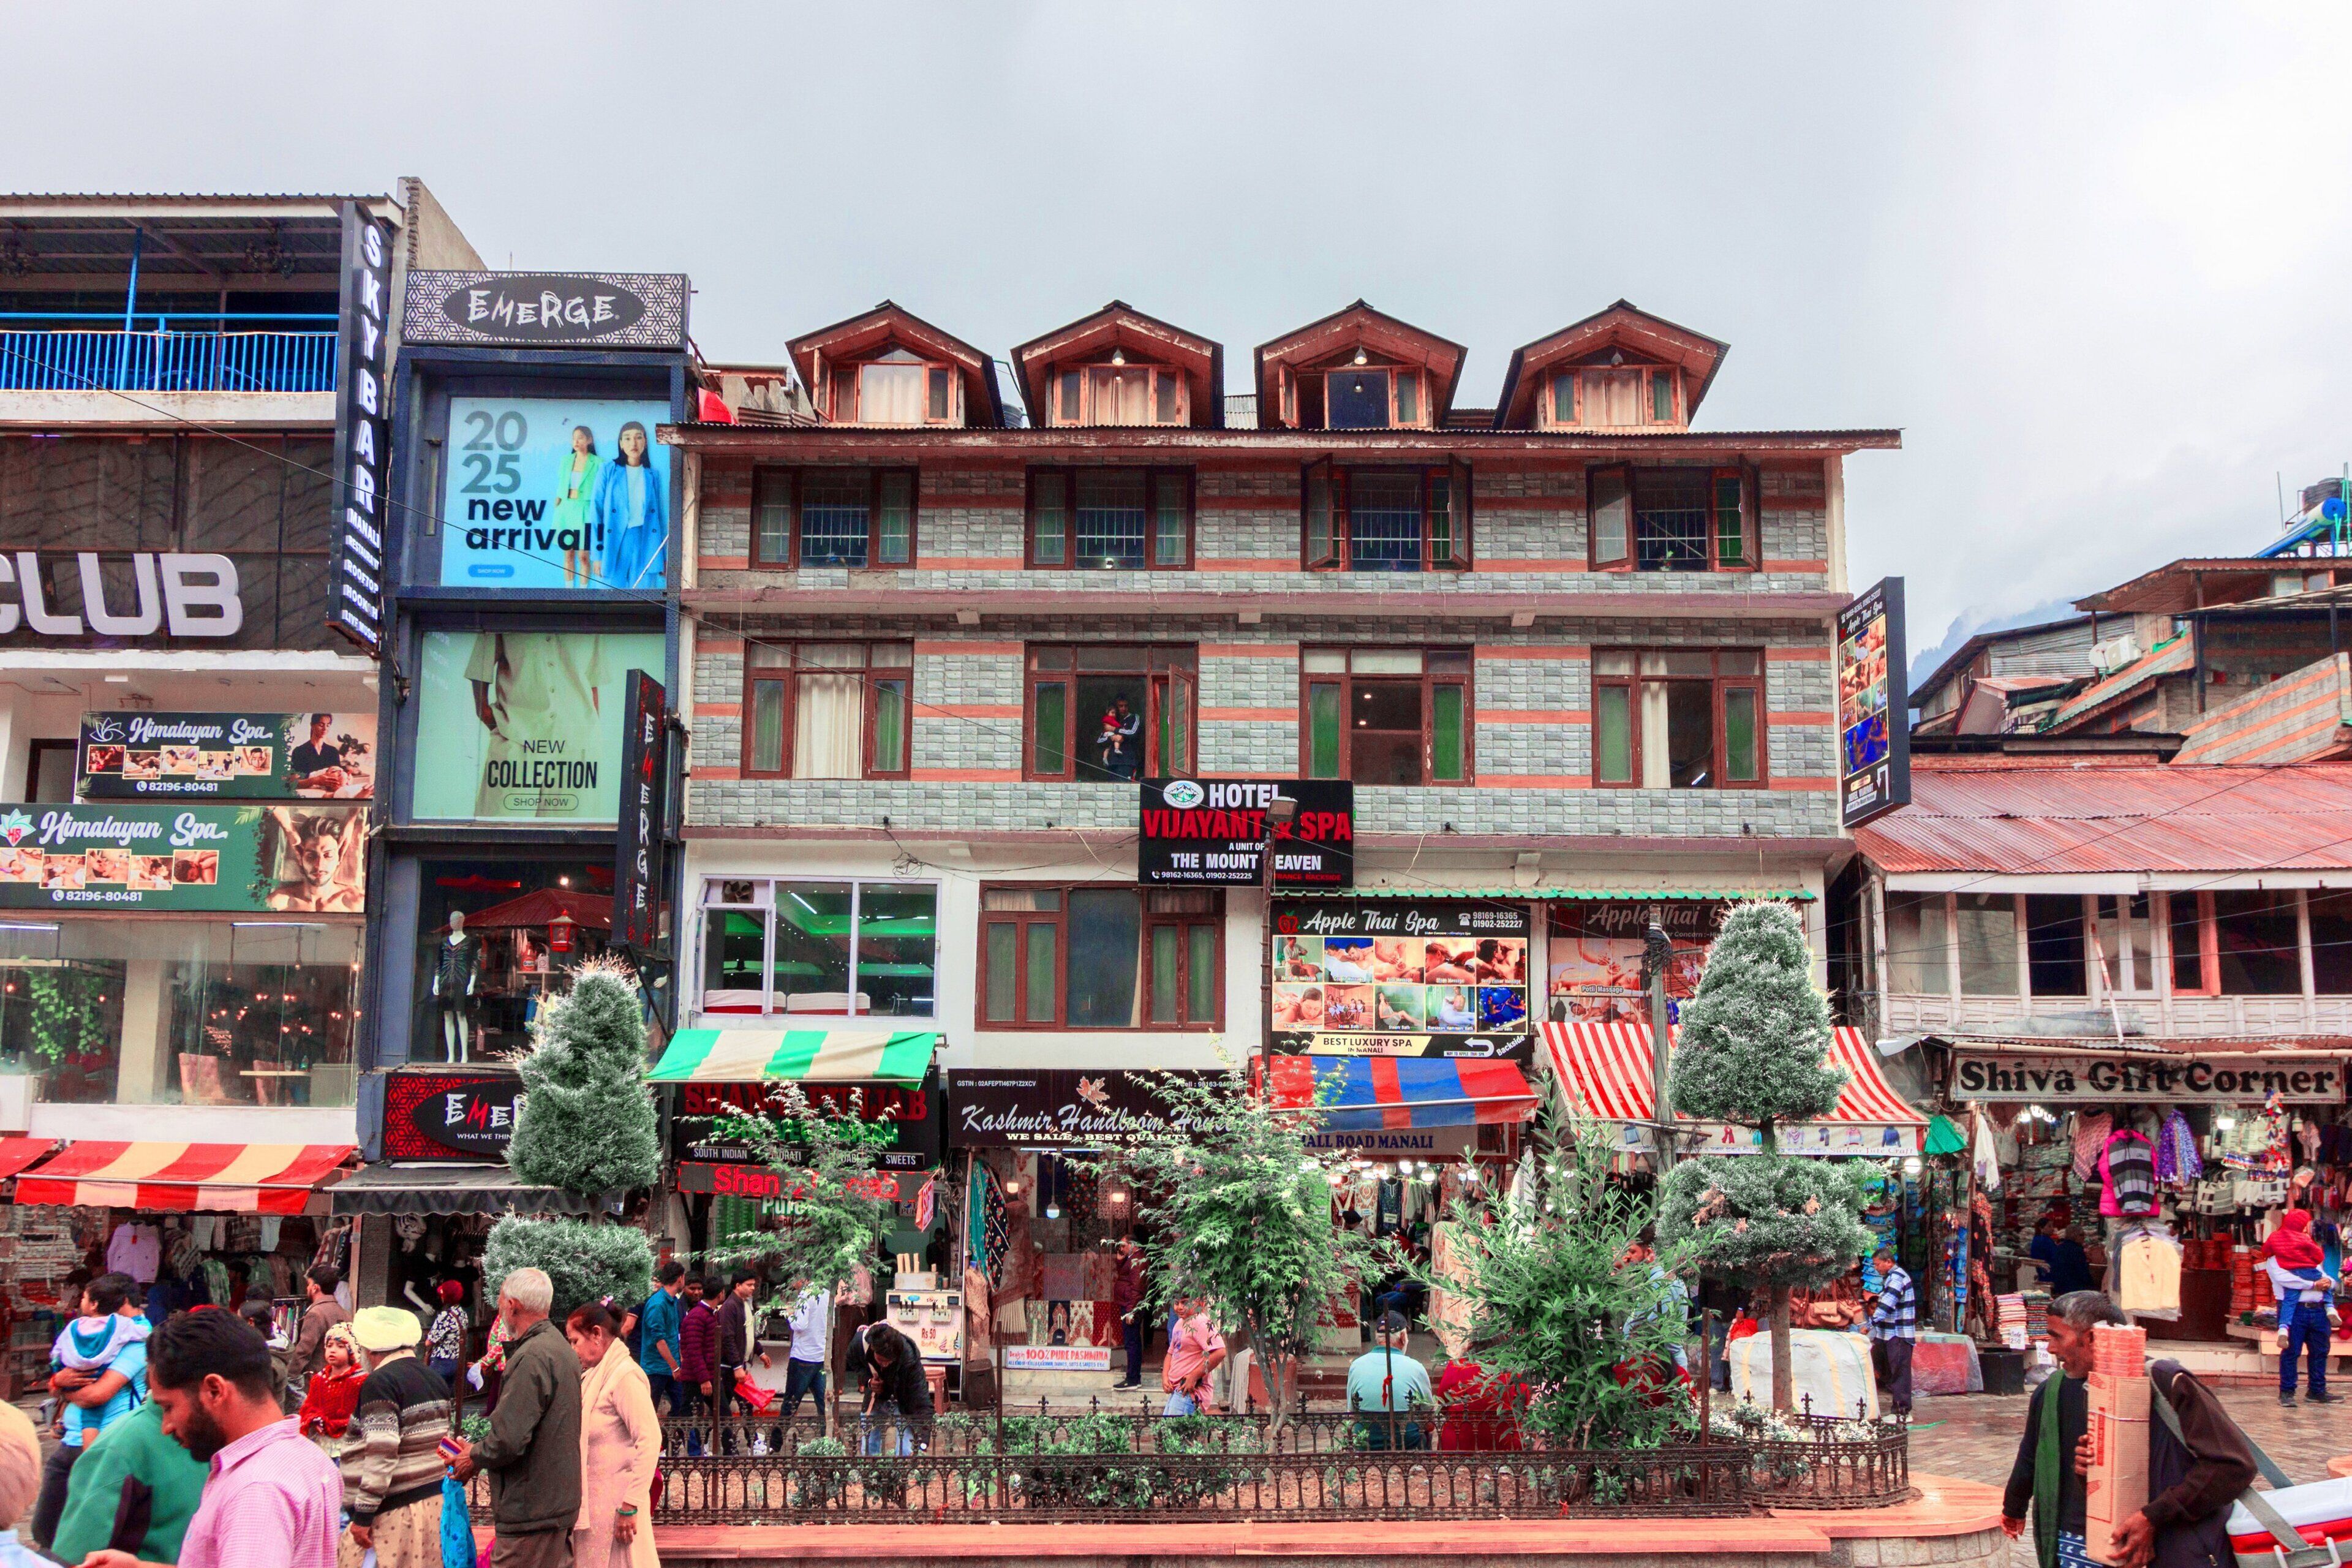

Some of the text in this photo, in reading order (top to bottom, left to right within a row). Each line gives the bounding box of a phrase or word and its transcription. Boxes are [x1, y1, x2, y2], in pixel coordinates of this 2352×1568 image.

[468, 290, 615, 330] EMERGE
[462, 410, 528, 451] 20
[460, 453, 522, 494] 25
[468, 496, 547, 521] new
[346, 508, 380, 549] MANALI
[466, 519, 605, 551] arrival!
[344, 559, 379, 594] ROOFTOP
[128, 717, 273, 744] Himalayan Spa
[524, 740, 565, 753] NEW
[149, 782, 218, 792] 82196-80481
[488, 760, 597, 788] COLLECTION
[39, 811, 228, 846] Himalayan Spa
[1300, 812, 1352, 841] SPA
[1171, 853, 1321, 870] THE MOUNT EAVEN
[66, 891, 142, 902] 82196-80481
[1303, 909, 1439, 936] Apple Thai Spa
[1587, 905, 1649, 930] Apple
[1392, 1039, 1412, 1047] SPA
[1496, 1035, 1525, 1057] Backside
[1960, 1060, 2335, 1095] Shiva Gift Corner
[961, 1104, 1052, 1132] Kashmir
[1057, 1103, 1164, 1133] Handloom
[694, 1148, 747, 1159] SOUTH INDIAN
[1335, 1134, 1374, 1148] ROAD
[1378, 1135, 1434, 1149] MANALI
[886, 1155, 916, 1165] SWEETS
[714, 1167, 780, 1194] Shan
[922, 1328, 937, 1339] Rs 50
[1027, 1349, 1050, 1360] 100%
[1050, 1349, 1069, 1360] PURE
[1071, 1350, 1108, 1360] PASHMINA
